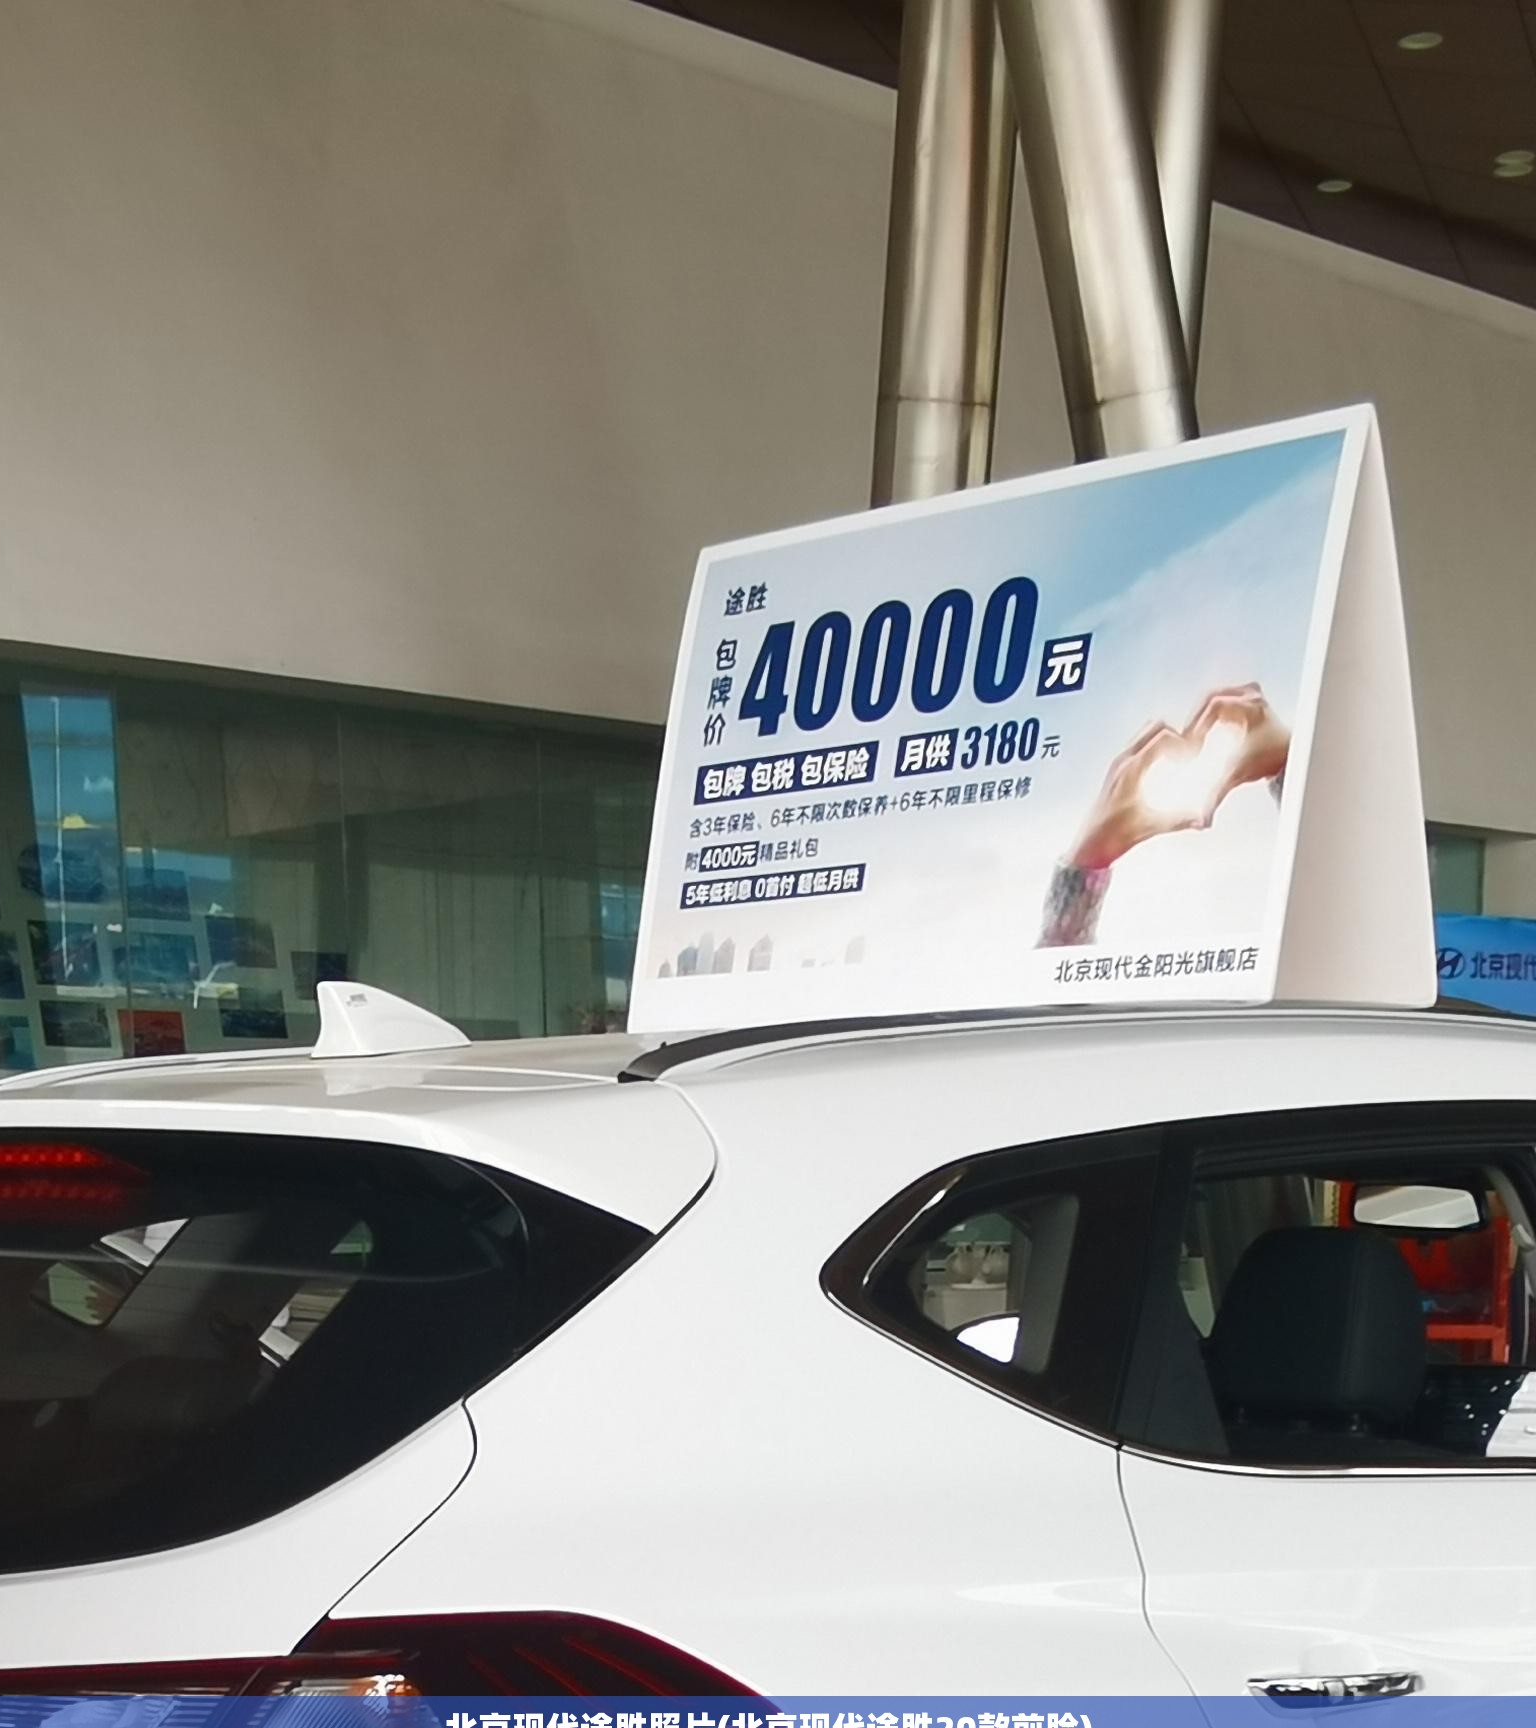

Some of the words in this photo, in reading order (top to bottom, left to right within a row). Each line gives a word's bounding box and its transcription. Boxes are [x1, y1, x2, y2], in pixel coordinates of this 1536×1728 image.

[724, 582, 768, 616] 途胜
[703, 638, 738, 747] 包牌价
[900, 733, 952, 772] 月供
[703, 764, 746, 798] 包牌
[751, 757, 795, 793] 包税
[801, 747, 871, 787] 包保险
[1054, 946, 1260, 983] 北京现代金阳光旗舰店
